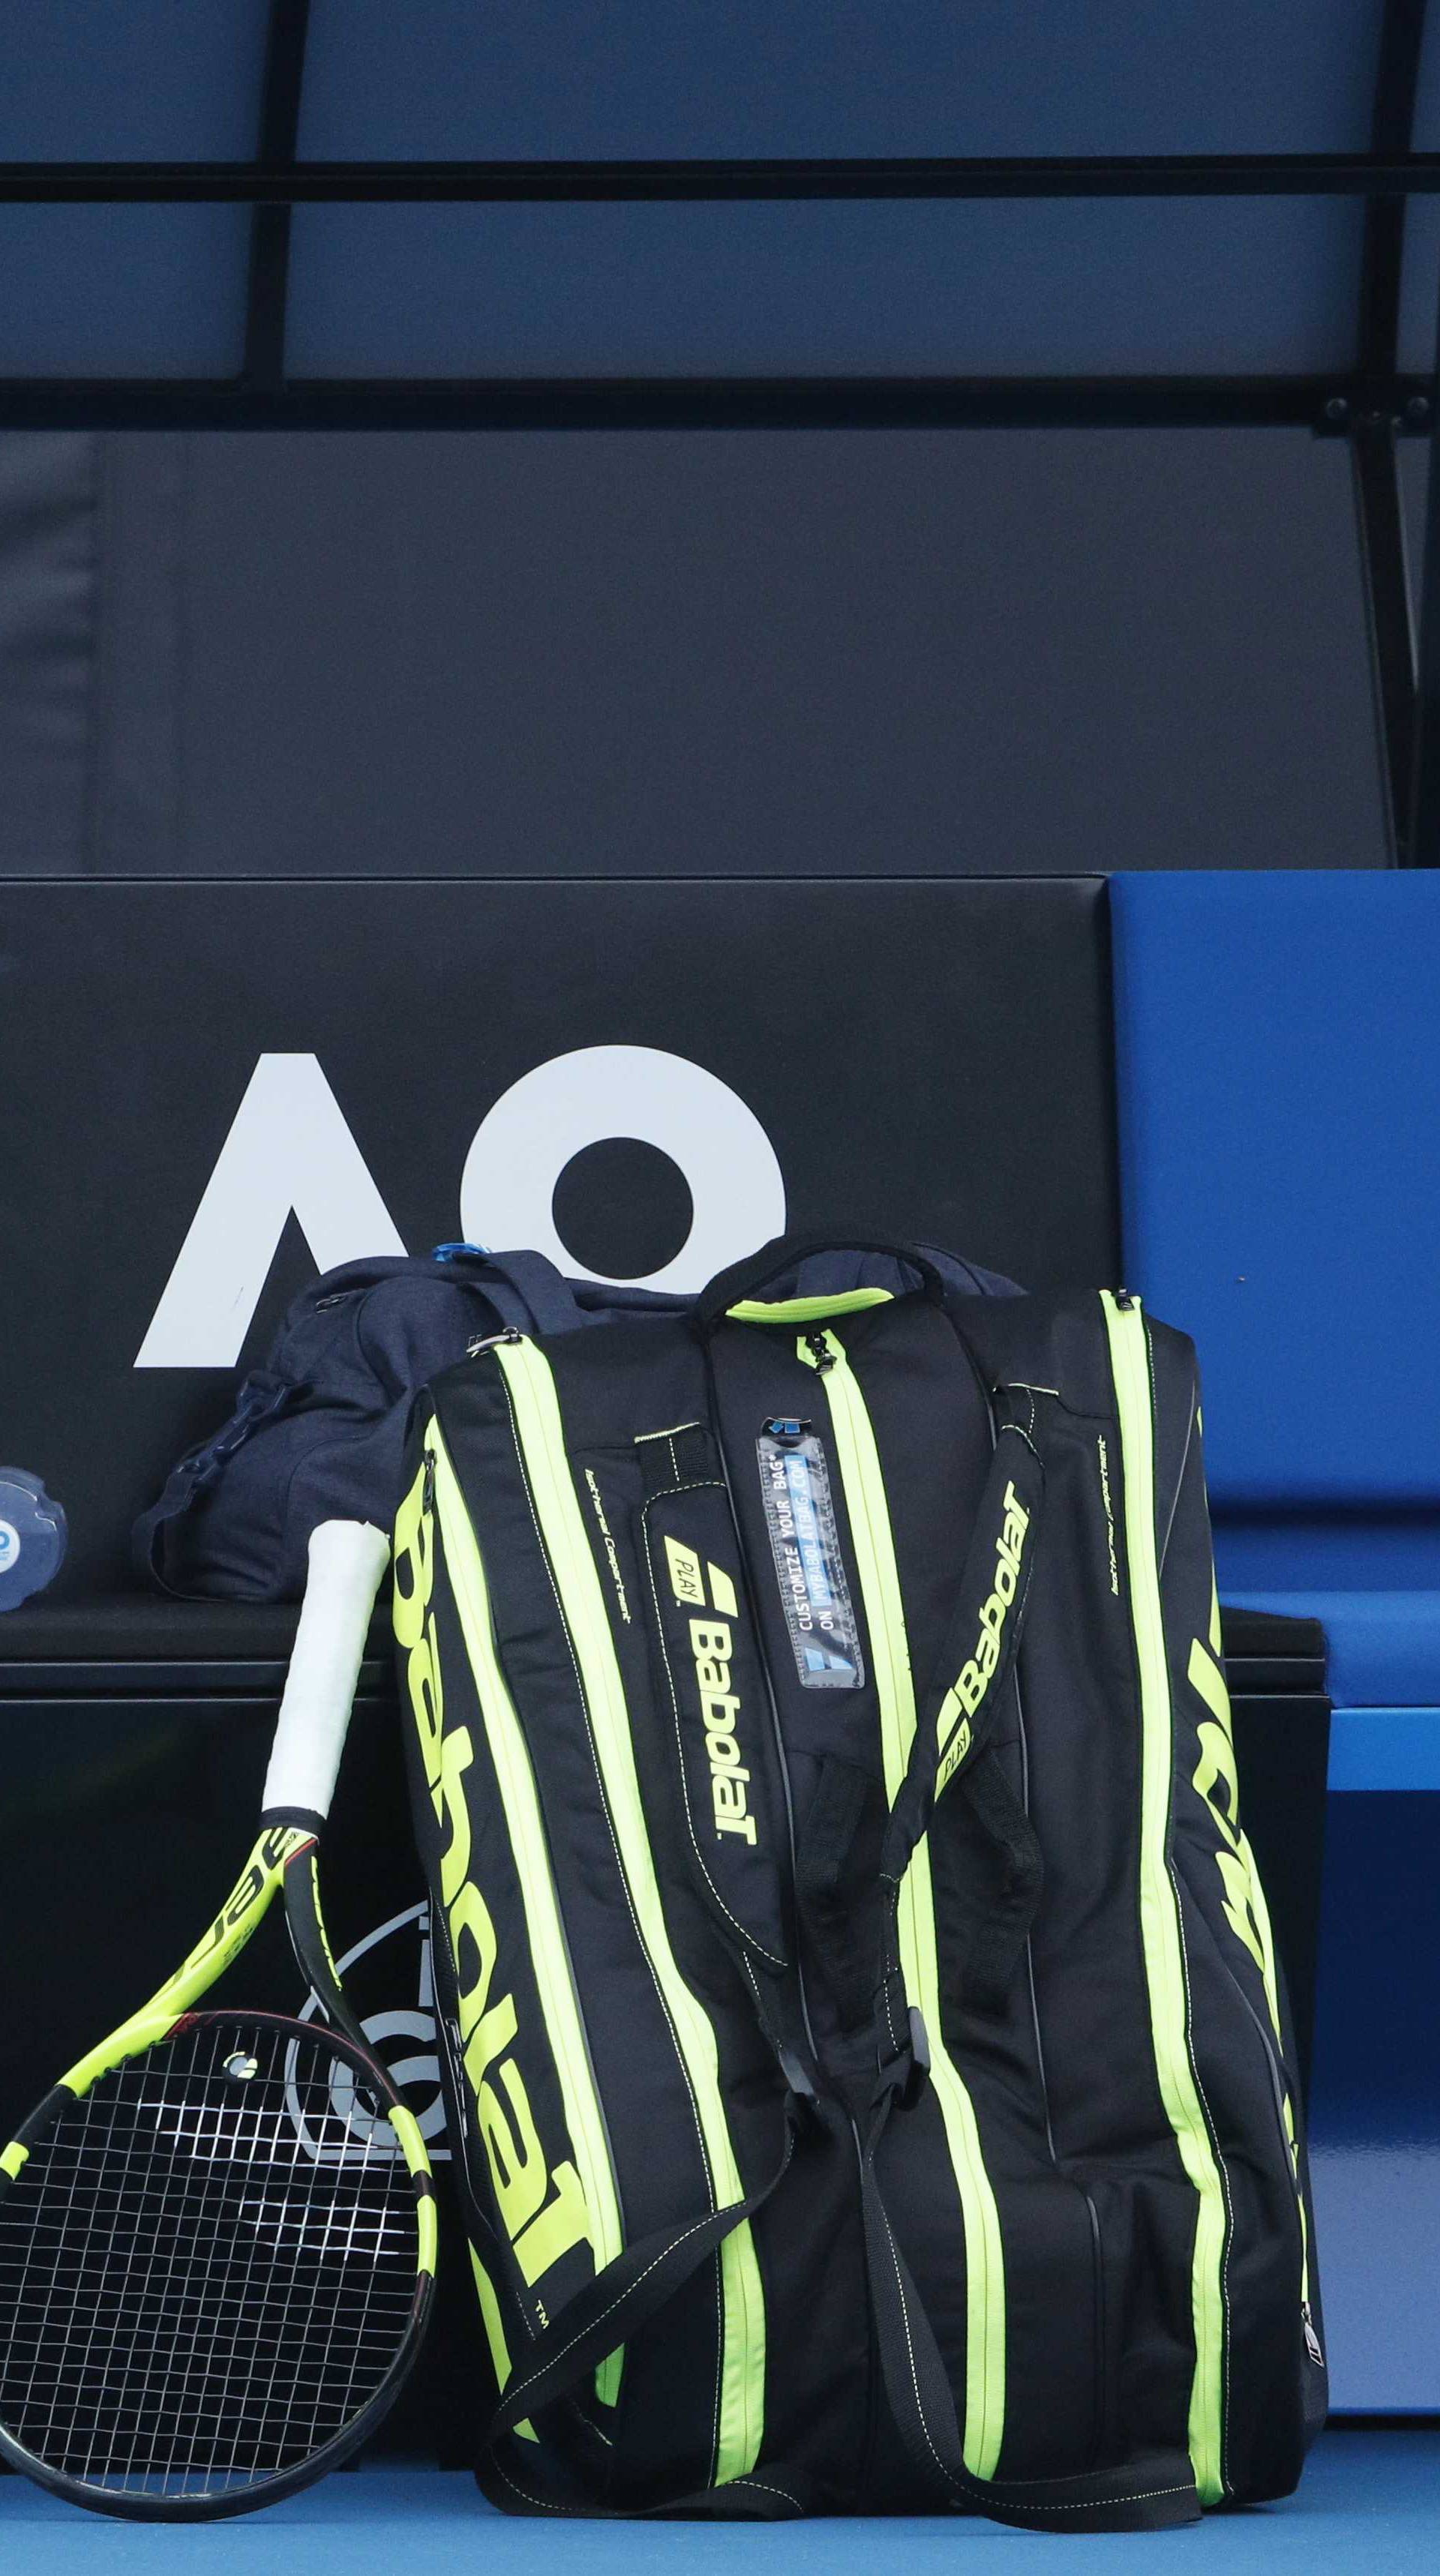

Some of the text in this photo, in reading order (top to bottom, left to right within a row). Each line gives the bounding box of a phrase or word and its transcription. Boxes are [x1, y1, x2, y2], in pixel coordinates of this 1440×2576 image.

[134, 1045, 787, 1368] AO
[584, 1468, 632, 1624] Isothermal Compartment
[776, 1499, 794, 1539] YOUR
[792, 1459, 834, 1631] ON MYBABOLATBAG.COM
[674, 1558, 699, 1599] PLAY
[785, 1546, 813, 1632] CUSTOMIZE
[943, 1728, 968, 1783] PLAY
